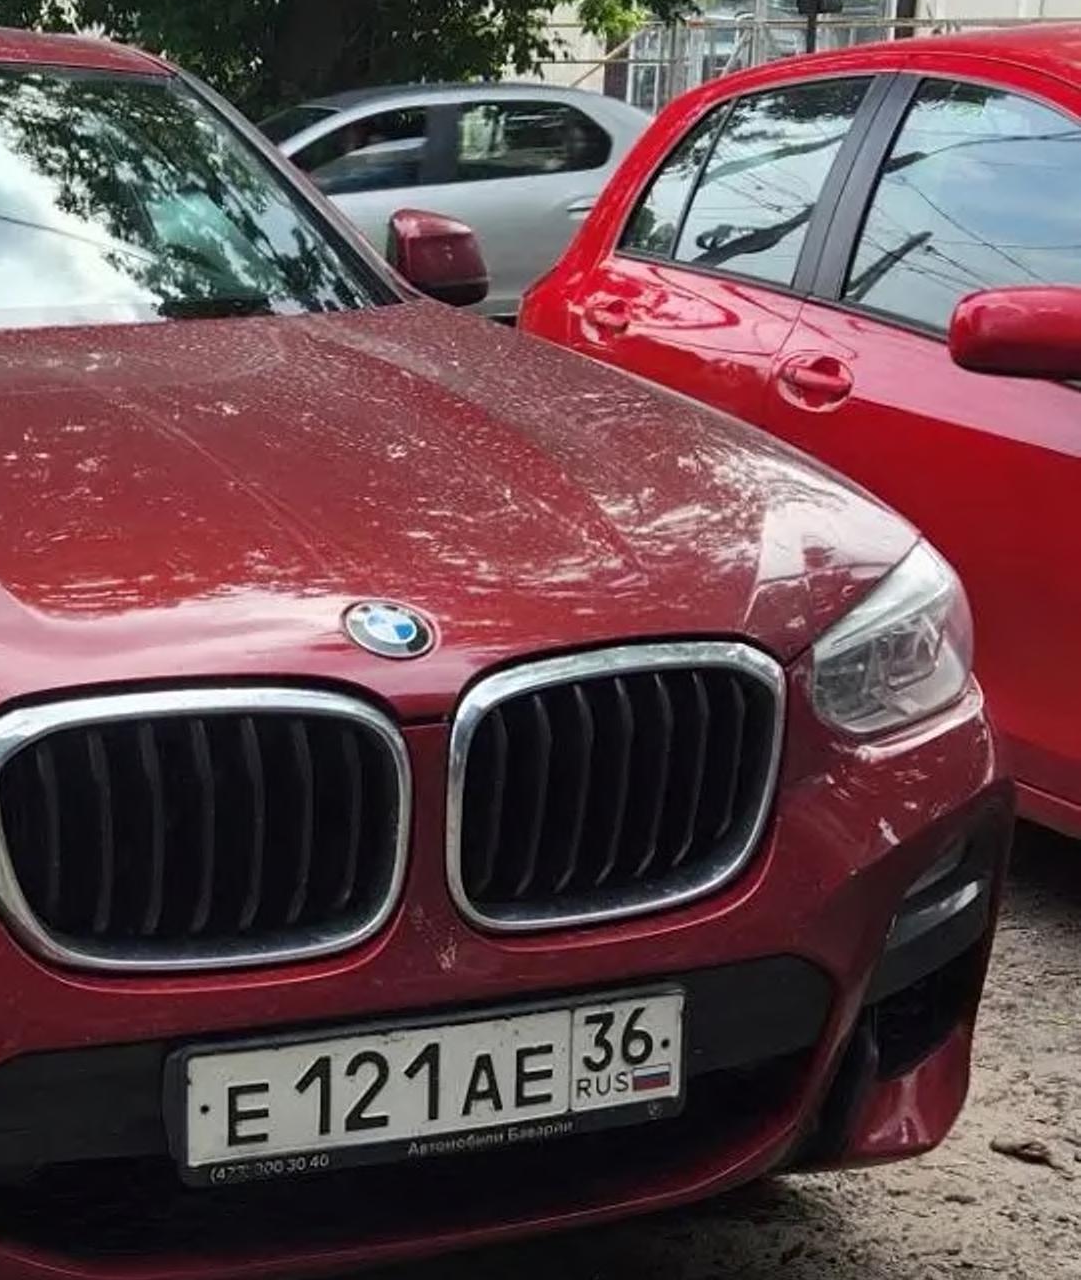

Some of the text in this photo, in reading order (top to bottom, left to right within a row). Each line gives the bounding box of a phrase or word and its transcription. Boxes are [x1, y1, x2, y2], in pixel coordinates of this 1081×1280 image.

[583, 1007, 653, 1072] 36
[577, 1071, 629, 1098] RUS
[310, 1153, 329, 1168] 40
